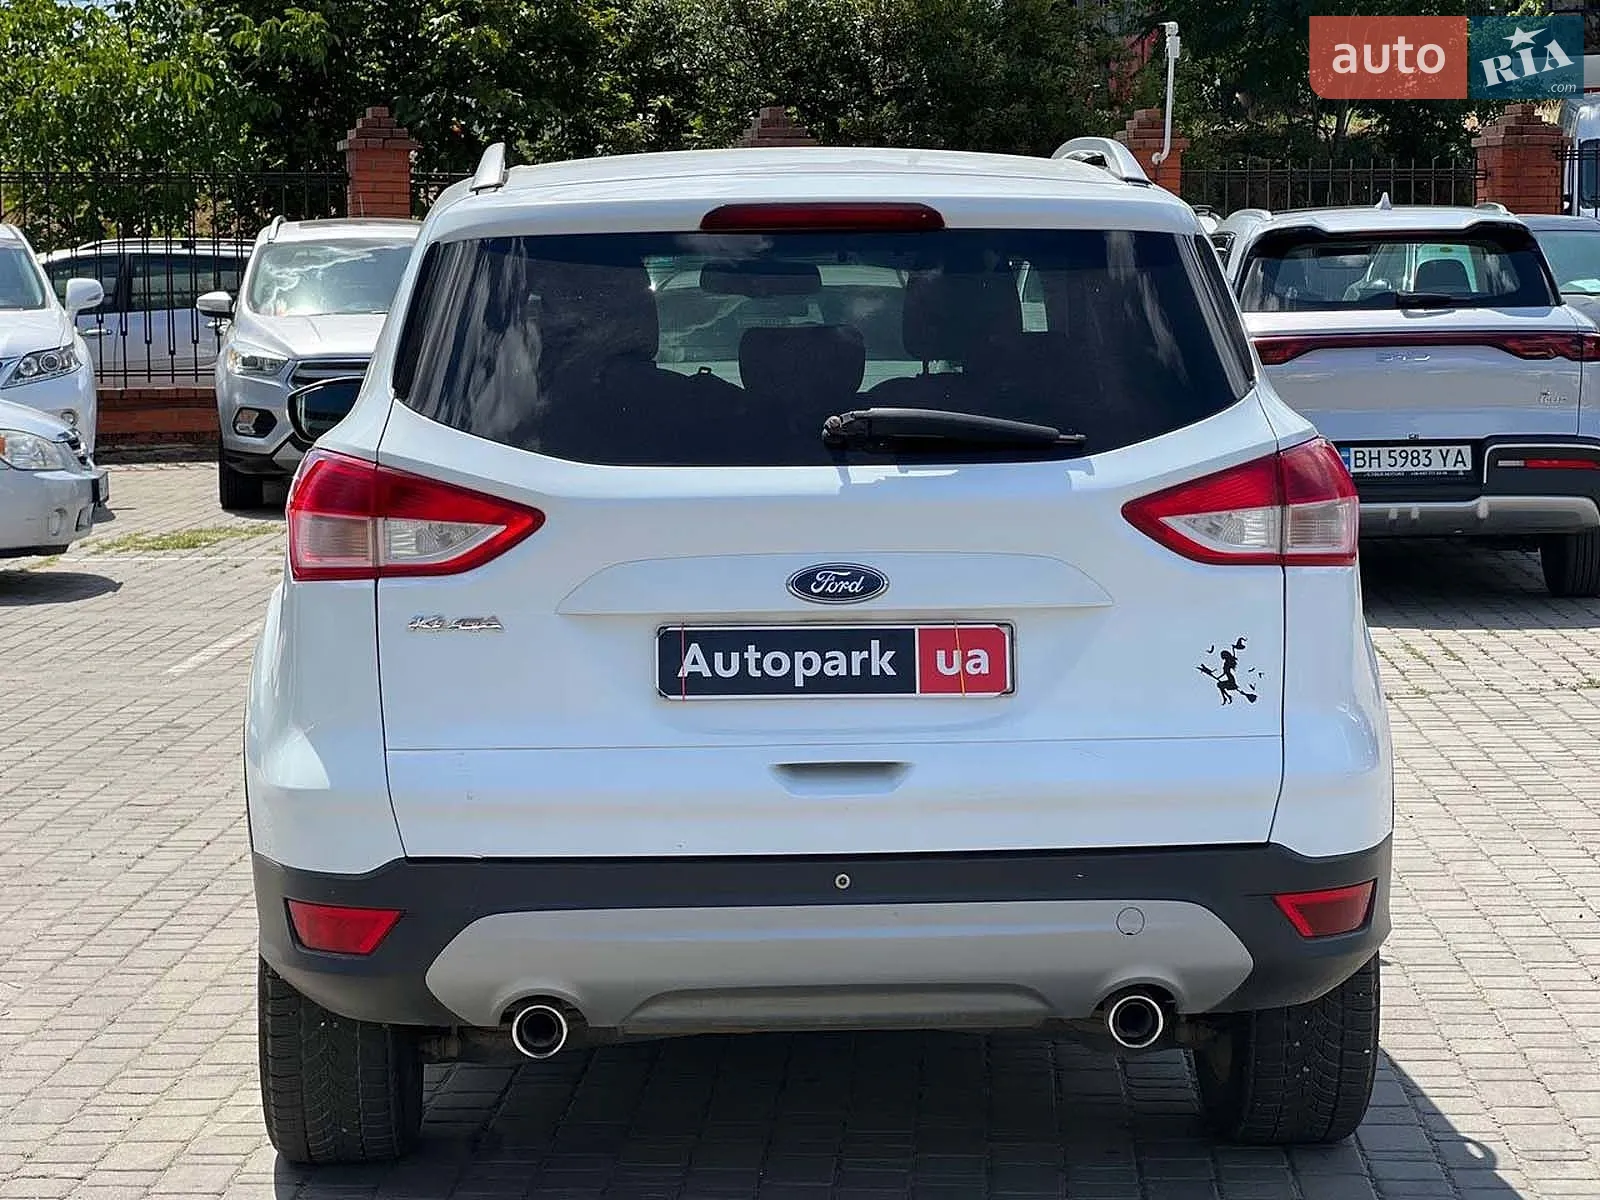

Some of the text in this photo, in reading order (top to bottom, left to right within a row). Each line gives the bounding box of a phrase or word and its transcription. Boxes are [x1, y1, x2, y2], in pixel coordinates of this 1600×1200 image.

[1353, 448, 1467, 468] BH 5983 YA
[810, 570, 865, 594] Ford
[677, 639, 989, 687] Autopark ua
